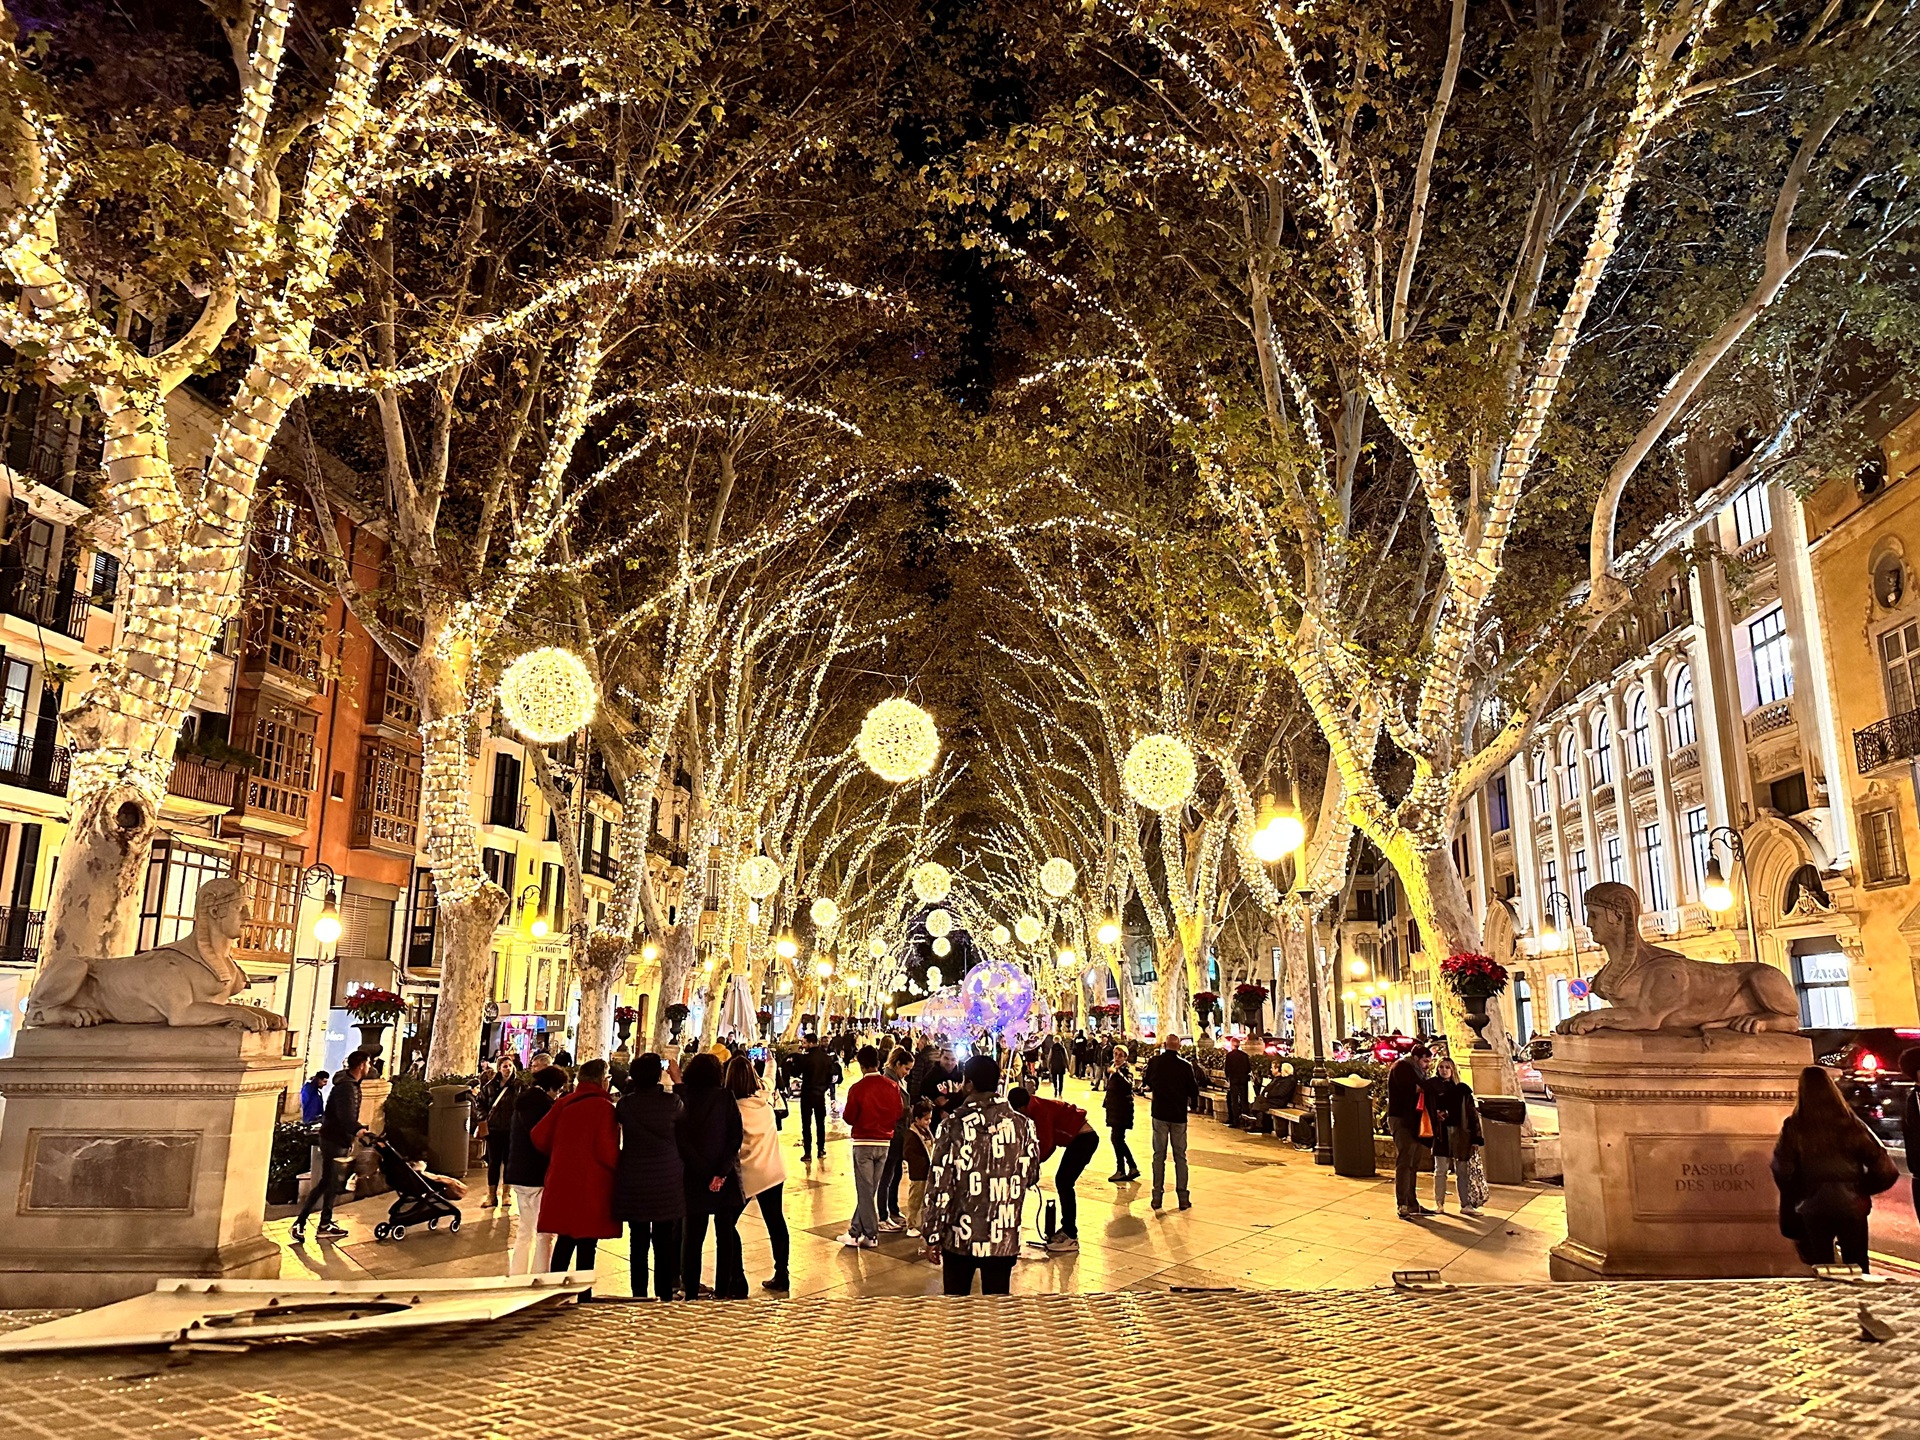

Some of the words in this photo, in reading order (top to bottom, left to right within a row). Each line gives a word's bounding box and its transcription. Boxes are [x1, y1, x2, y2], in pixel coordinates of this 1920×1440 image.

[1681, 1163, 1745, 1176] PASSEIG
[1675, 1179, 1704, 1191] DES
[1712, 1179, 1755, 1191] BORN
